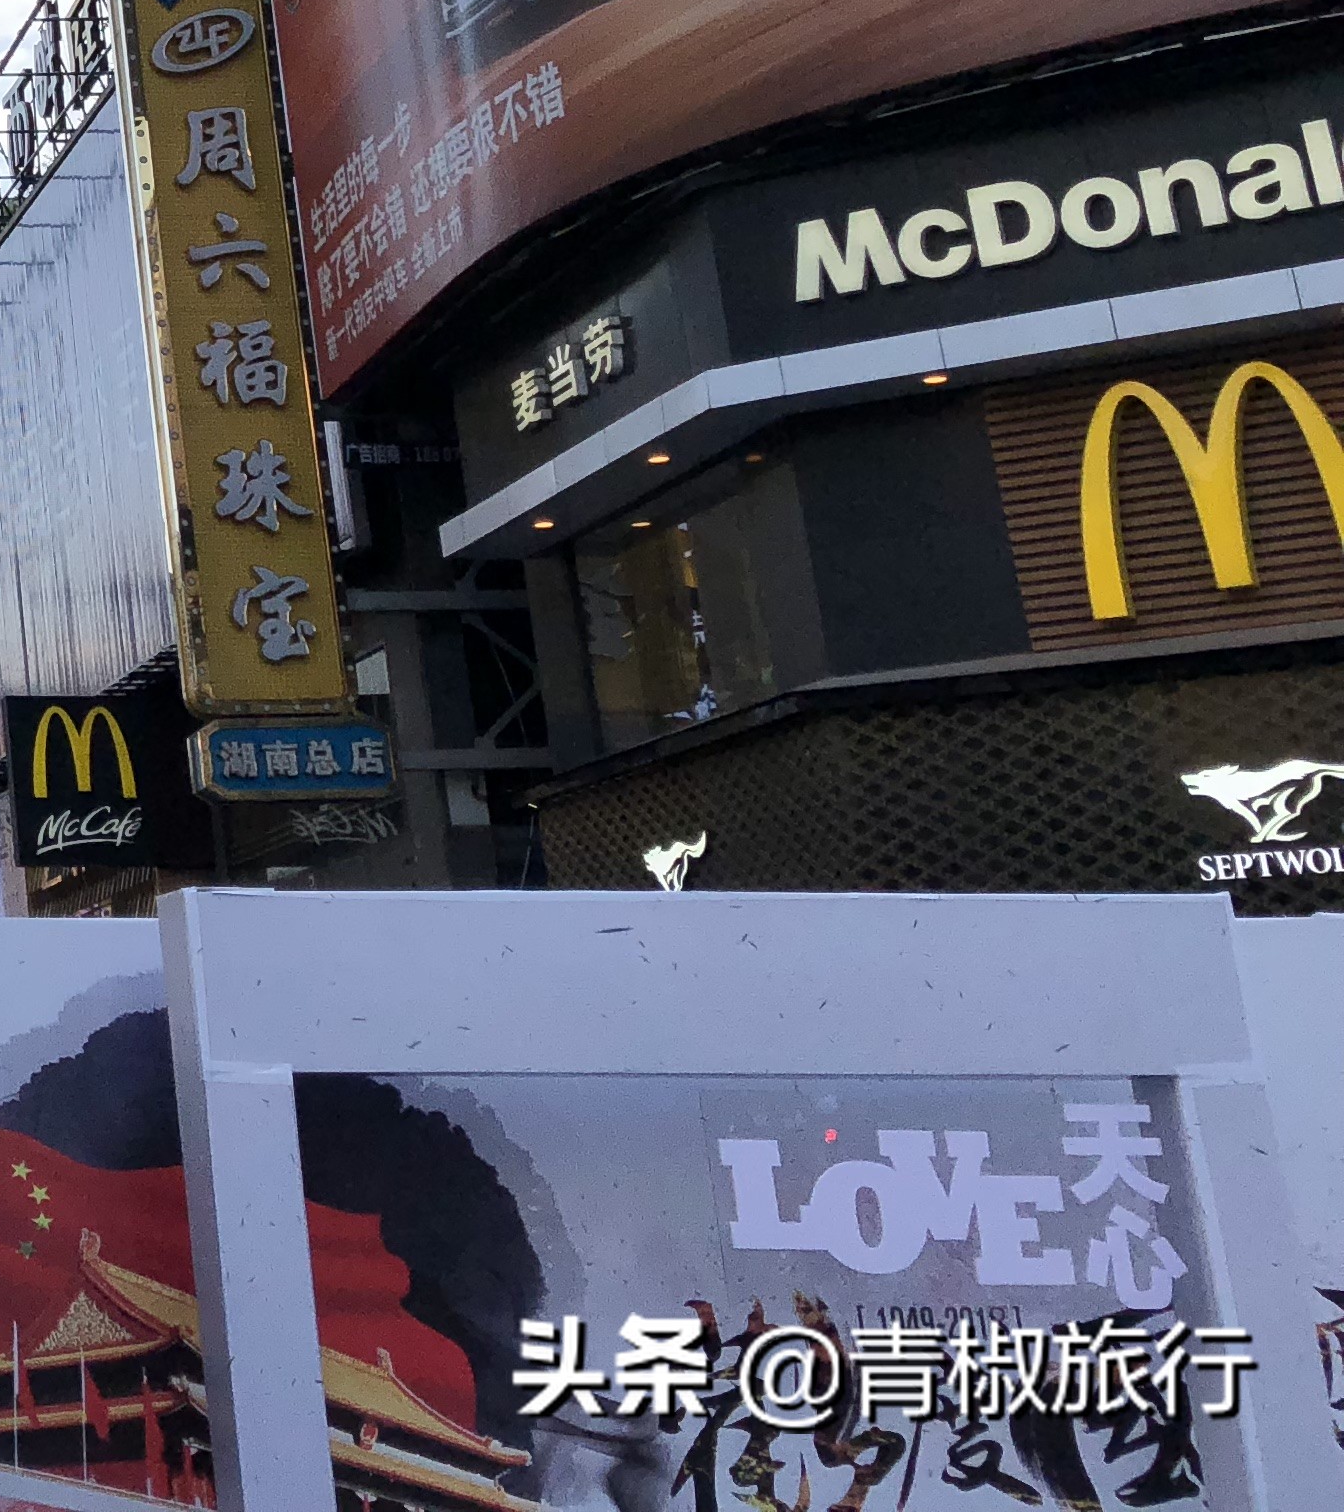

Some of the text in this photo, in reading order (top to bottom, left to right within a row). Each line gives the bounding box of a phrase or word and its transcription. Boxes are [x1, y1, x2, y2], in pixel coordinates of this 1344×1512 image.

[176, 105, 316, 662] 周六福珠宝
[511, 316, 626, 432] 麦当劳
[220, 737, 385, 780] 湖南总店
[718, 1129, 1075, 1287] LOVE
[1062, 1103, 1187, 1310] 天心
